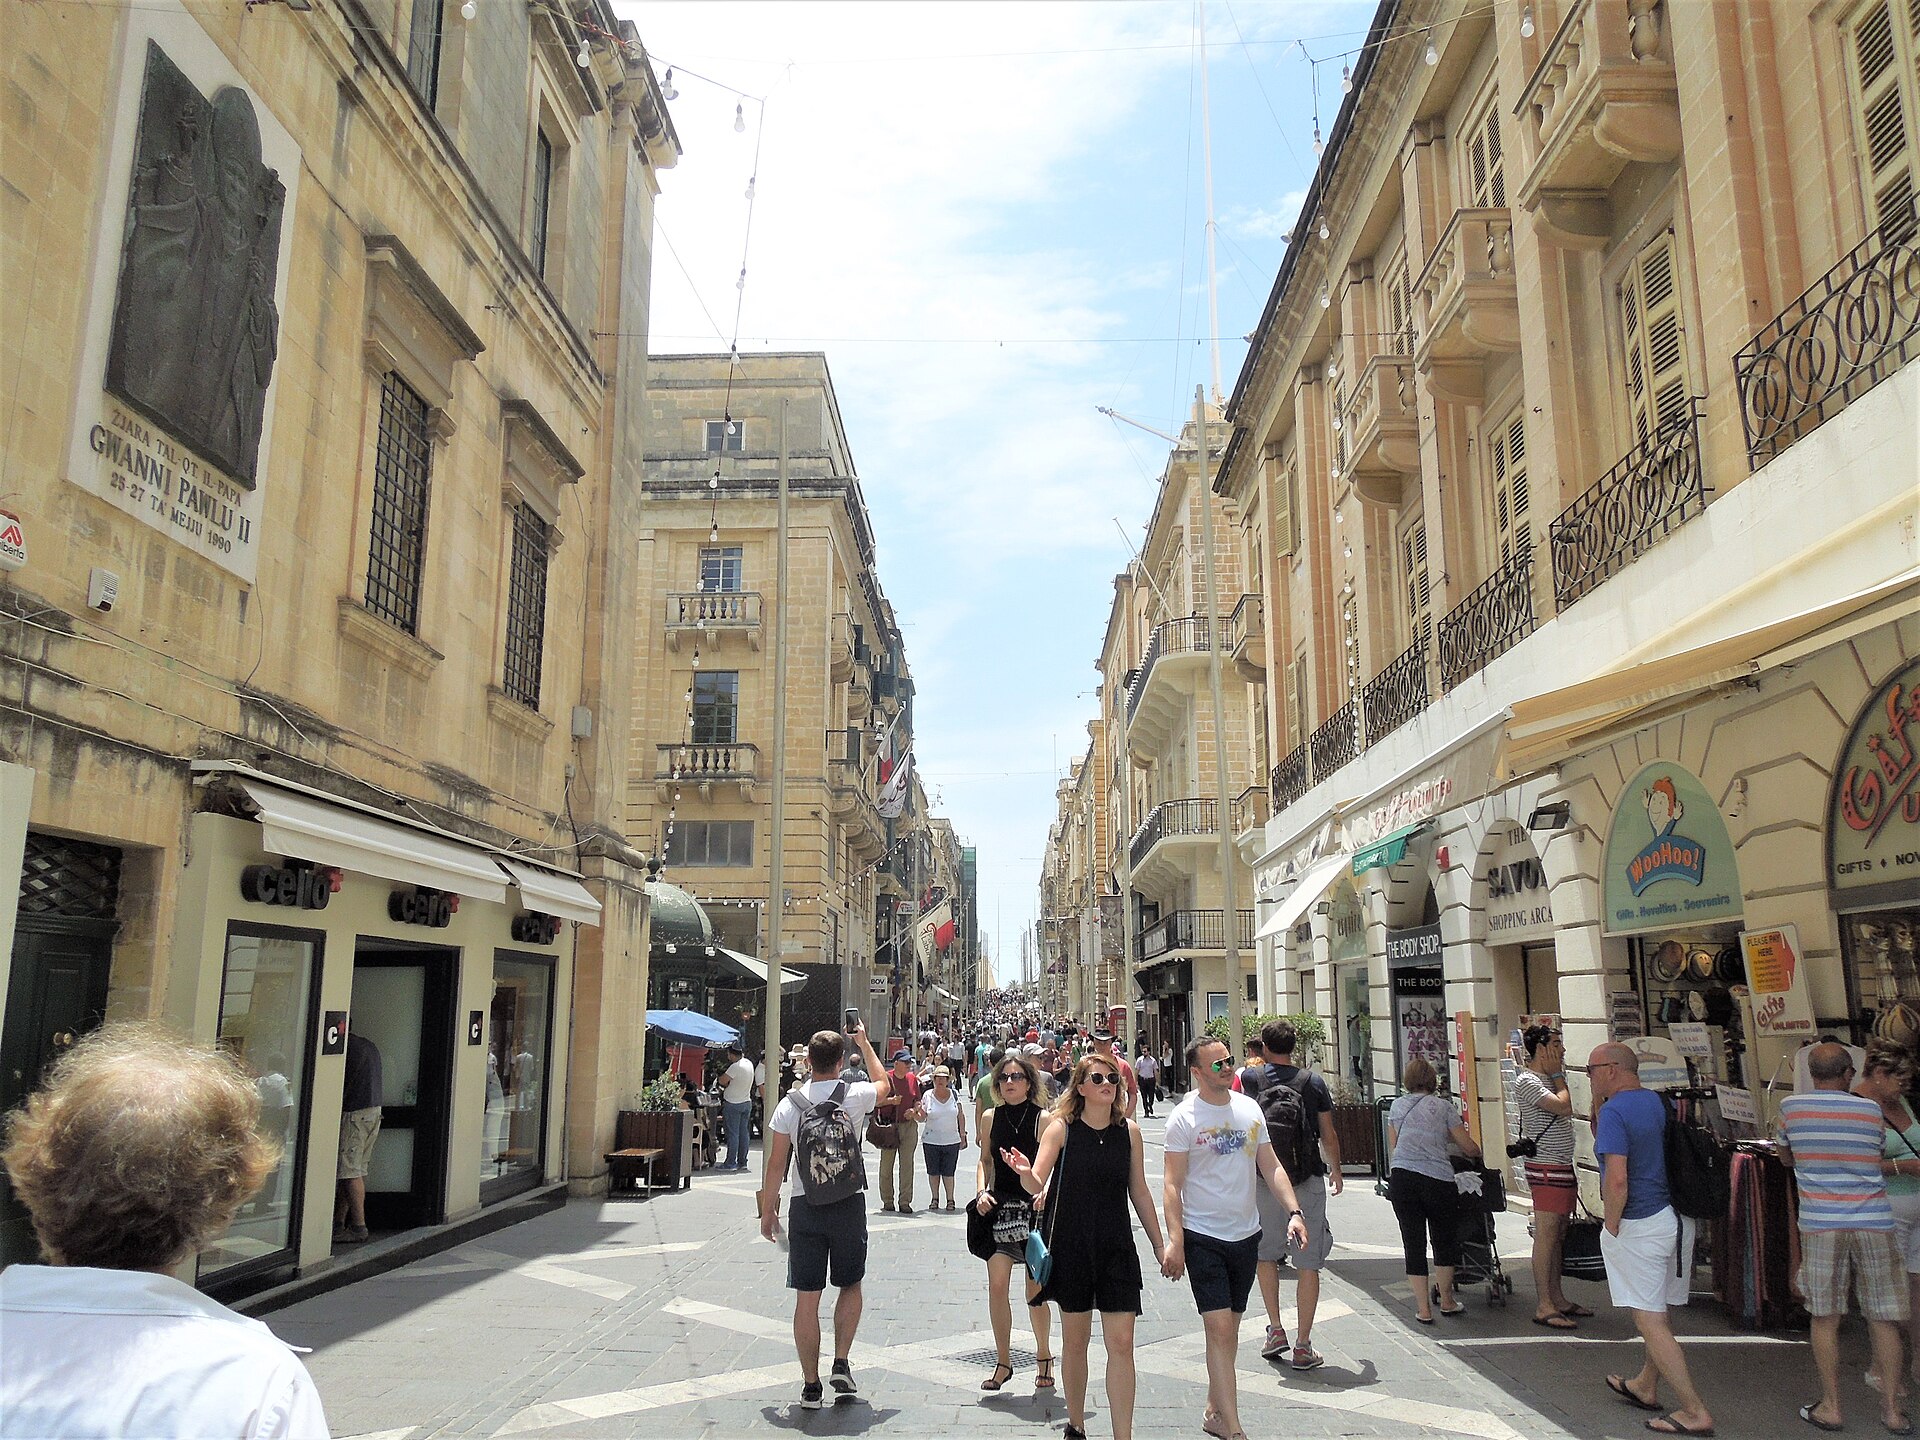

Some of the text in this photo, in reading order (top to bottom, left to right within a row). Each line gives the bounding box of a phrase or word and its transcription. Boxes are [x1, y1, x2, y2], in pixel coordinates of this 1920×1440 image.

[111, 471, 145, 502] 25-27
[170, 506, 203, 536] MEJJU
[208, 530, 232, 554] 1990
[178, 476, 233, 531] PAWLU
[238, 515, 251, 544] II
[0, 540, 25, 560] lberta
[1507, 826, 1527, 846] THE
[1837, 851, 1920, 874] GIFTS NOV
[1488, 906, 1553, 931] SHOPPING ARCA
[1387, 942, 1400, 959] THE
[1400, 938, 1418, 958] BODY
[1747, 936, 1768, 947] PLEASE
[1398, 977, 1441, 988] THE BOD
